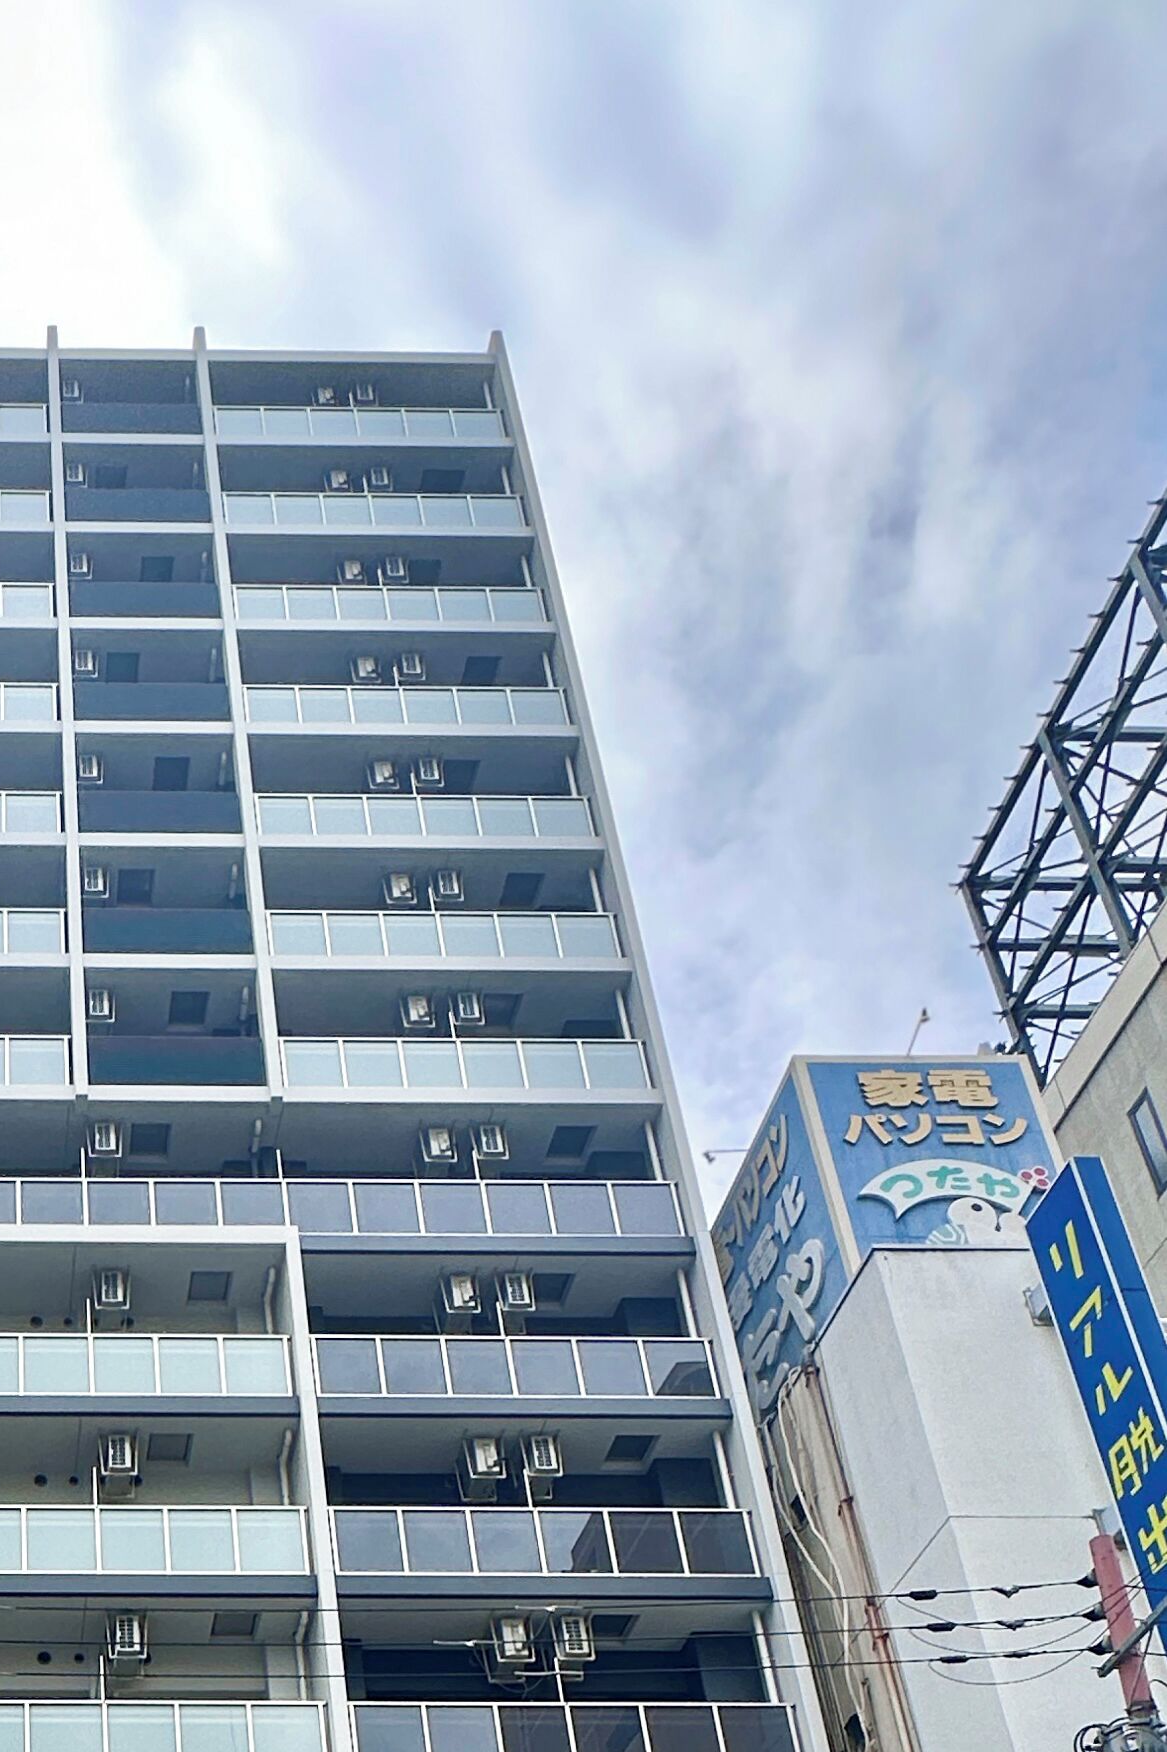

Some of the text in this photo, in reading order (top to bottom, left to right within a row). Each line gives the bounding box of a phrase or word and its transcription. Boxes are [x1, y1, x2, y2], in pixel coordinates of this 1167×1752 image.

[858, 1069, 1000, 1107] 家電
[844, 1113, 1028, 1145] パソコン
[880, 1165, 1020, 1199] つたや
